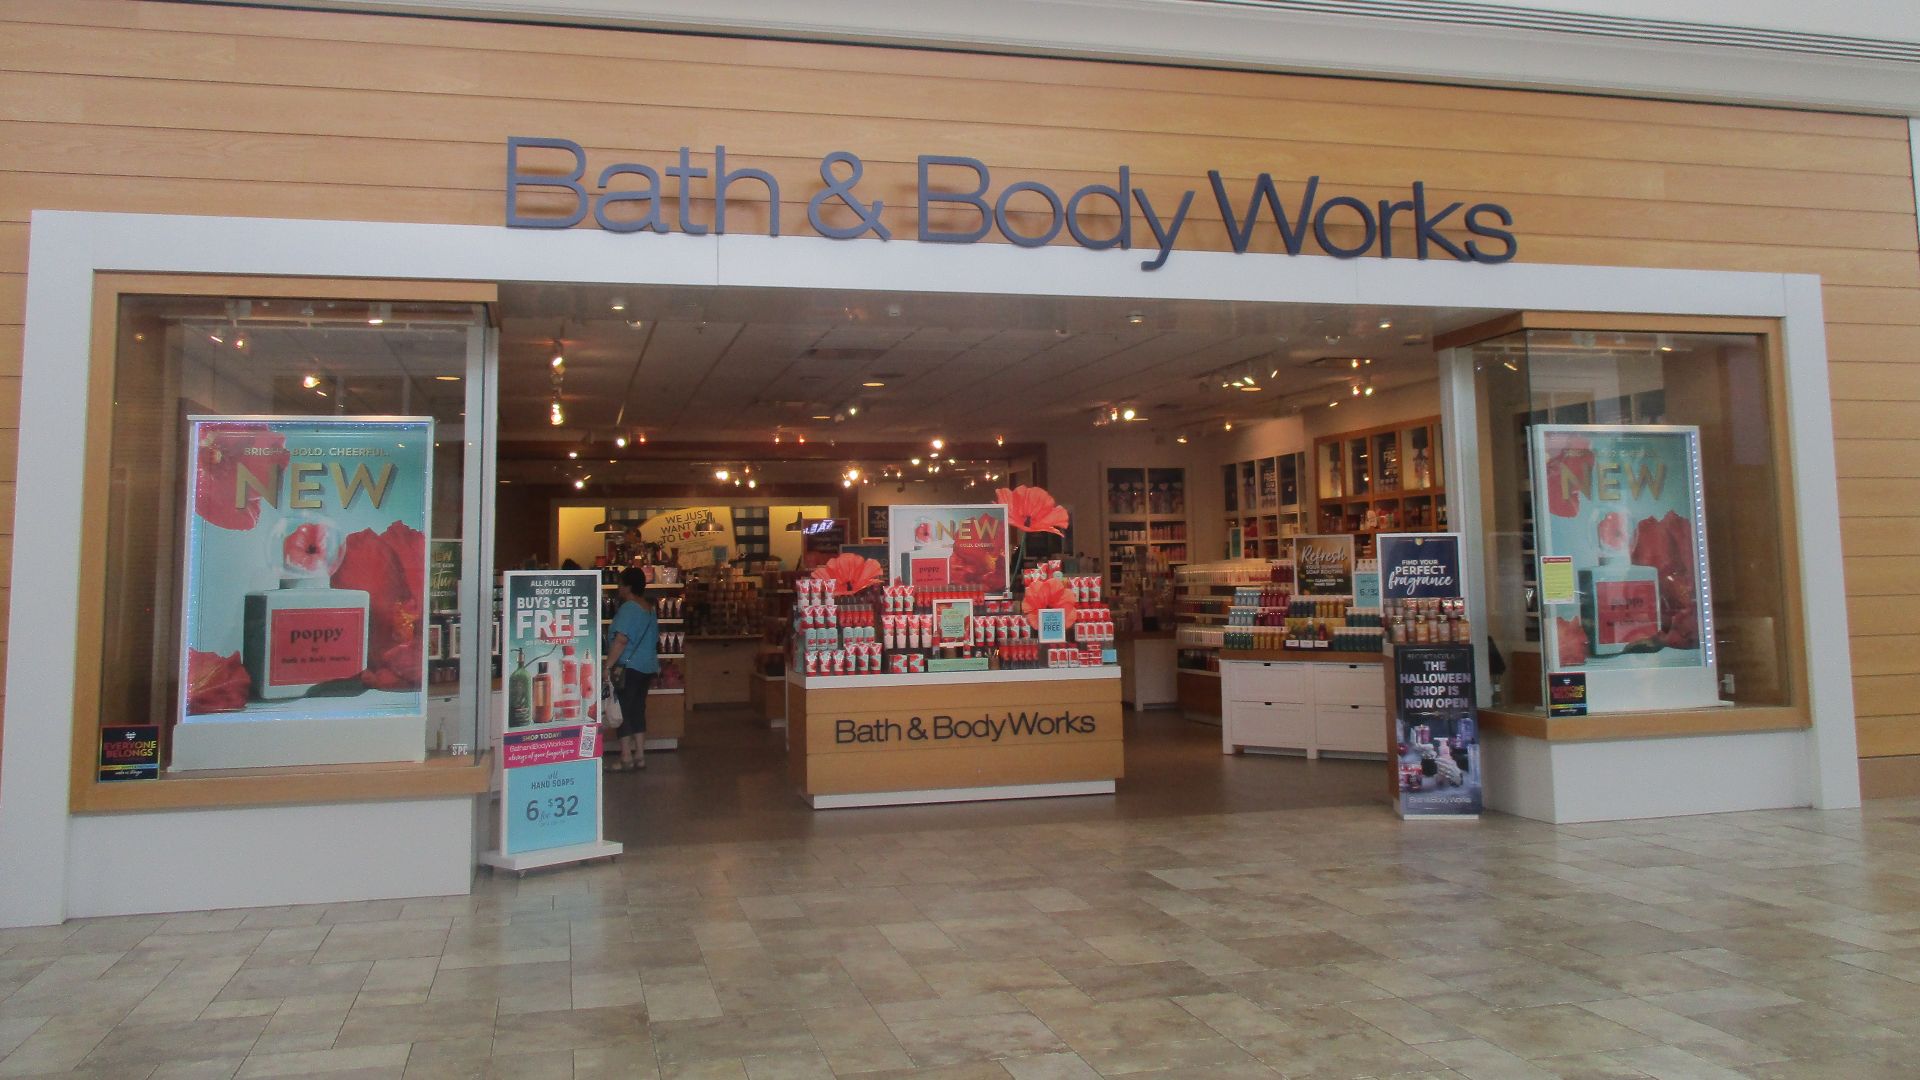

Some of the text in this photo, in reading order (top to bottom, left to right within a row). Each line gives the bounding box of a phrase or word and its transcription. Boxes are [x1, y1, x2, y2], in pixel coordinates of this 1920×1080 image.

[506, 135, 1518, 271] Bath & Body Works
[235, 462, 396, 509] NEW
[1560, 463, 1666, 501] NEW
[665, 509, 709, 524] WE JUST
[660, 522, 691, 534] WANT
[936, 520, 999, 540] NEW
[660, 534, 675, 544] TO
[1301, 544, 1346, 566] Refresh
[1395, 565, 1446, 575] PERFECT
[544, 579, 576, 587] FULL-SIZE
[1388, 571, 1453, 595] fragrance
[535, 587, 571, 595] BODY CARE
[516, 608, 589, 639] FREE
[1043, 624, 1061, 632] FREE
[290, 627, 344, 644] poppy
[1424, 661, 1447, 671] THE
[1400, 673, 1471, 684] HALLOWEEN
[1413, 686, 1459, 696] SHOP IS
[1405, 698, 1468, 708] NOW OPEN
[836, 711, 1096, 744] Bath & Body Works
[522, 734, 539, 742] SHOP
[104, 740, 157, 751] EVERYONE
[452, 745, 468, 756] SPC
[106, 748, 154, 758] BELONGS
[531, 778, 575, 790] HAND SOAPS
[526, 800, 540, 822] 6
